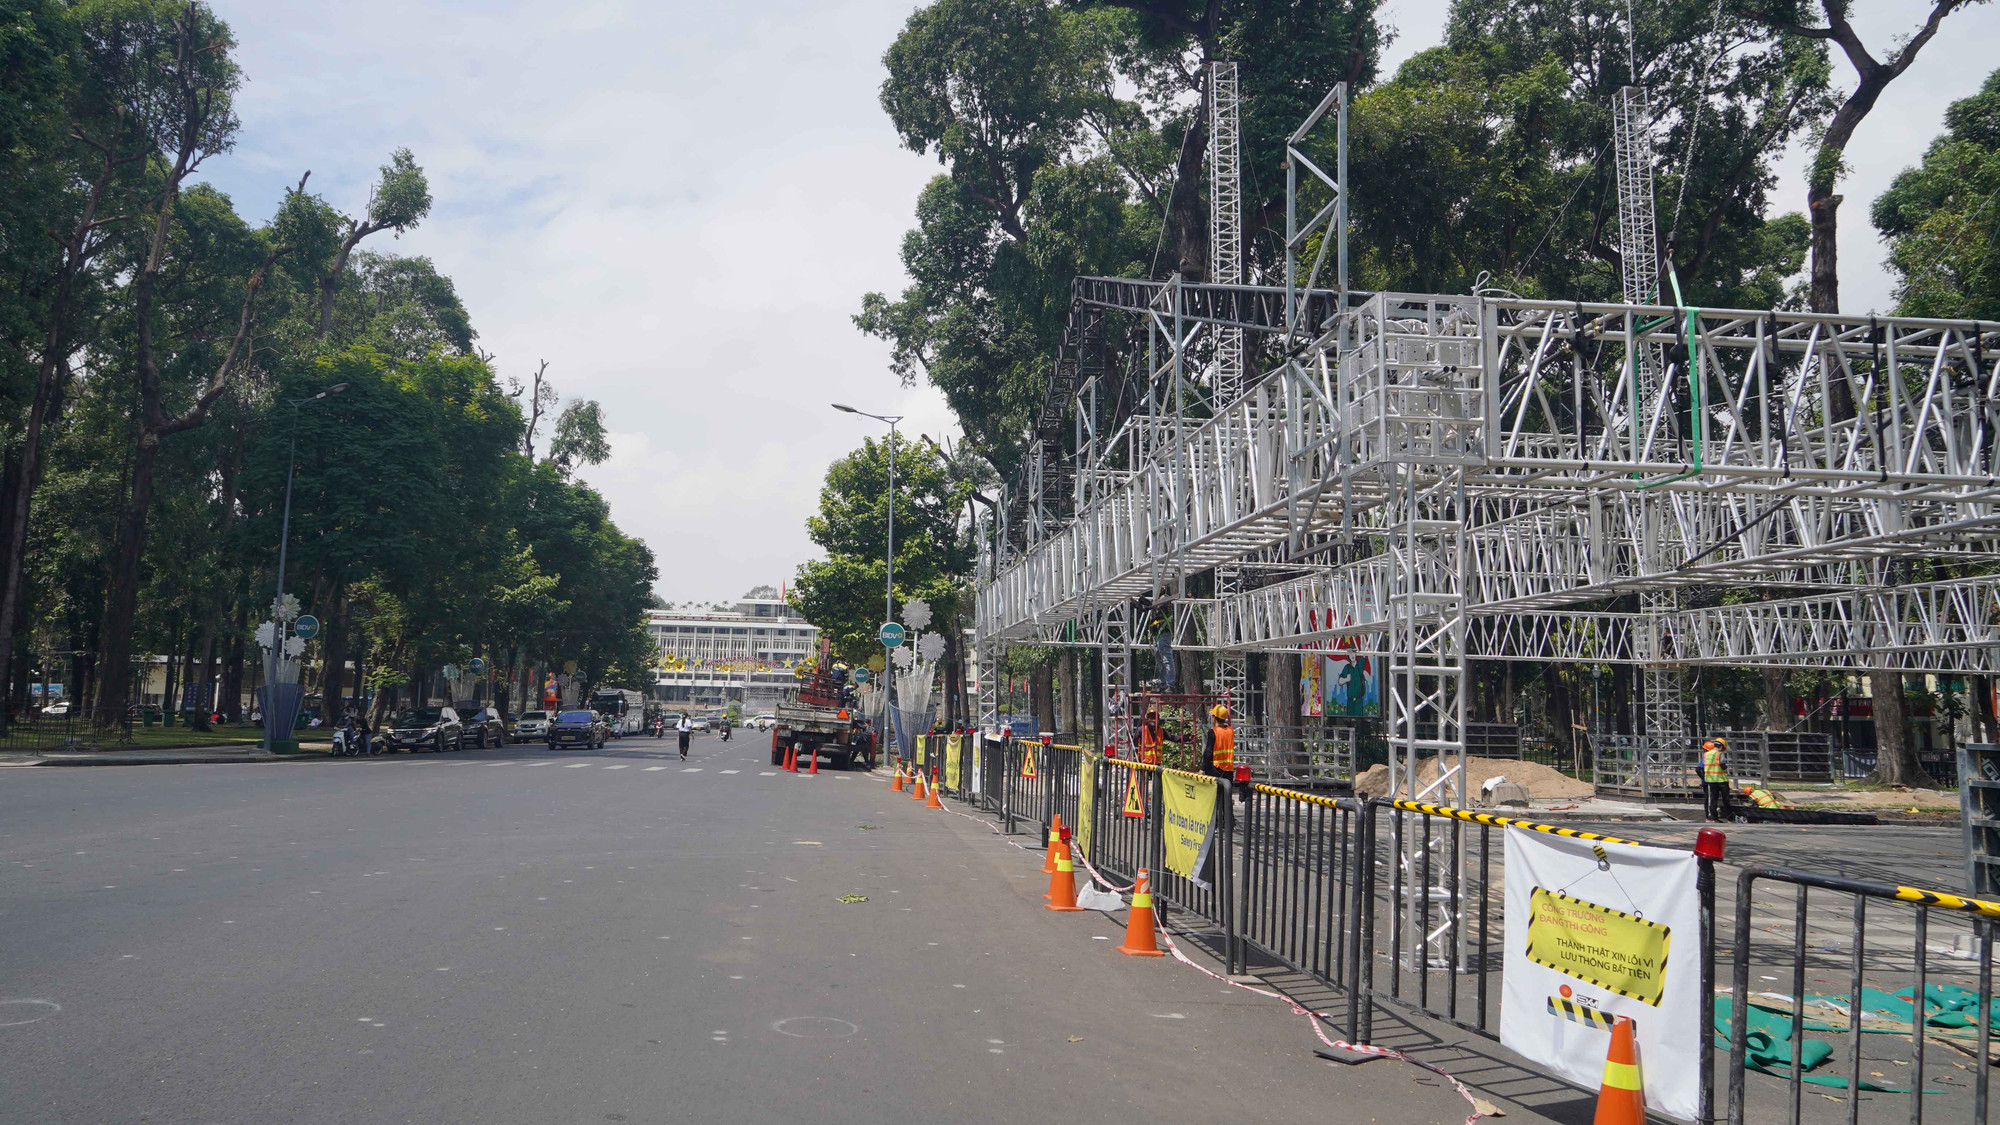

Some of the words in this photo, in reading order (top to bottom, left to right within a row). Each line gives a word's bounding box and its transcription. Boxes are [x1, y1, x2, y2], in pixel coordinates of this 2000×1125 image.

[882, 631, 898, 640] BIDV
[1541, 902, 1565, 916] CÔNG
[1539, 914, 1564, 928] ĐANG
[1564, 919, 1579, 931] THI
[1580, 923, 1608, 937] CÔNG
[1556, 937, 1586, 952] THÀNH
[1586, 944, 1611, 959] THẬT
[1611, 951, 1626, 963] XIN
[1642, 957, 1655, 969] VÌ
[1578, 955, 1611, 971] THÔNG
[1628, 967, 1651, 981] TIỆN
